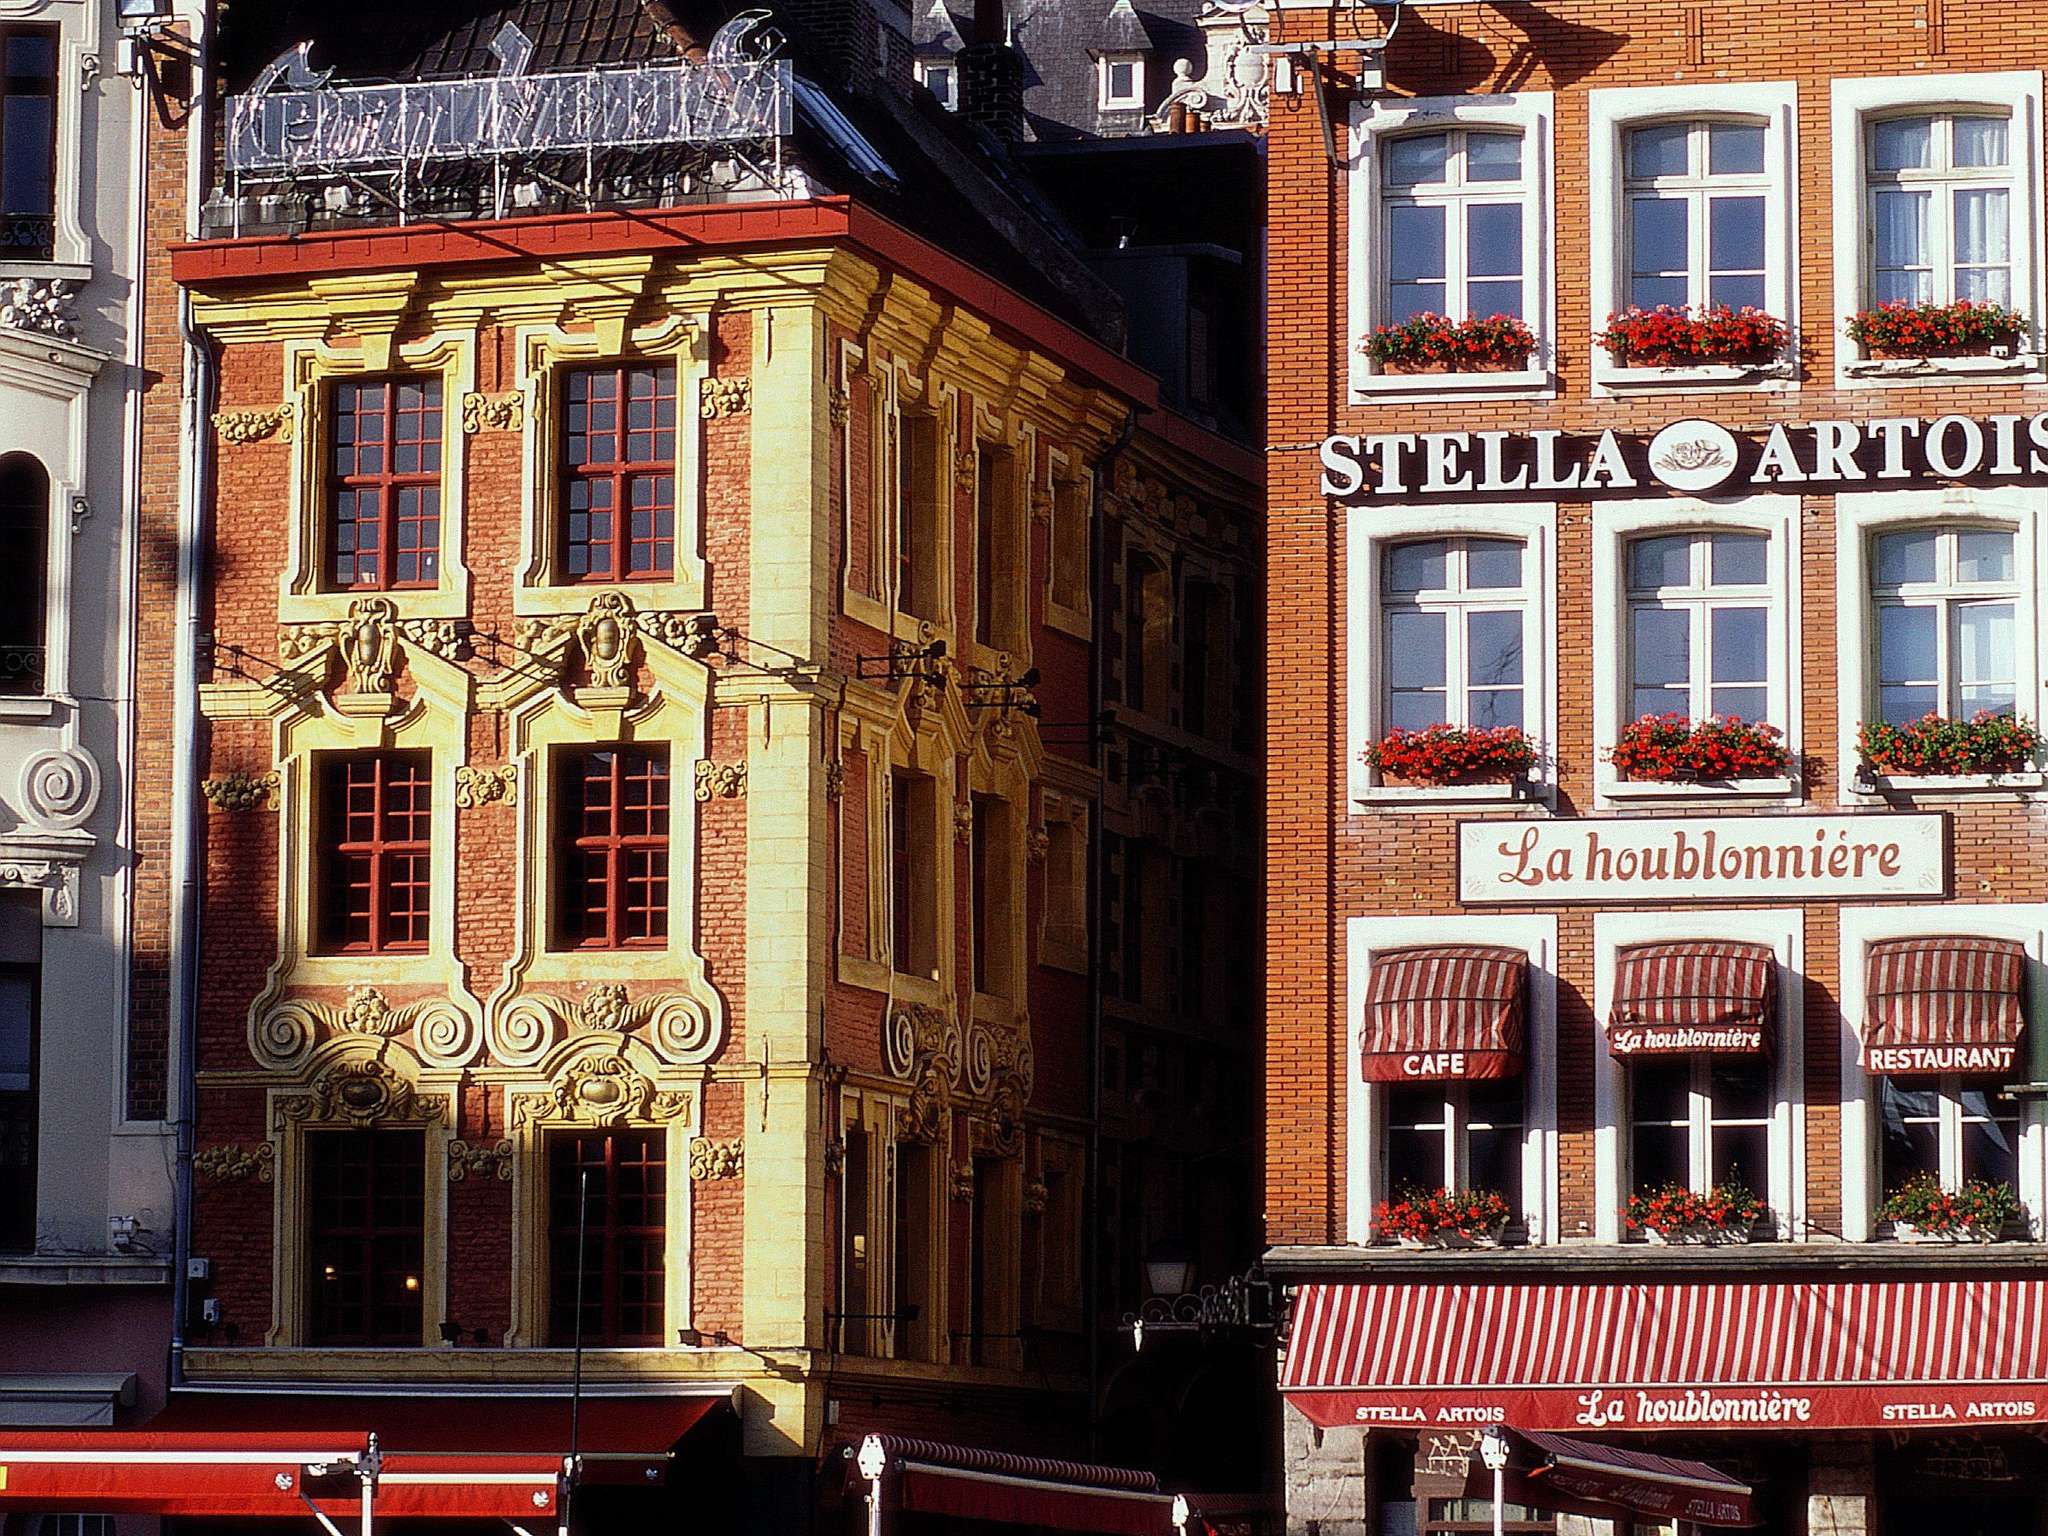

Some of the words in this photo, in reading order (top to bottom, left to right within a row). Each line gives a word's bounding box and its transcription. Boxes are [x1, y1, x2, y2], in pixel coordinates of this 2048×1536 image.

[1320, 428, 1637, 496] STELLA
[1498, 827, 1572, 886] La
[1614, 1029, 1642, 1053] La
[1644, 1027, 1761, 1049] houblonnière
[1403, 1053, 1464, 1076] CAFE
[1870, 1047, 2016, 1070] RESTAURANT
[1355, 1406, 1427, 1422] STELLA
[1436, 1406, 1506, 1422] ARTOIS
[1576, 1389, 1625, 1427] La
[1636, 1390, 1811, 1423] houblonnière
[1882, 1403, 1957, 1420] STELLA
[1965, 1401, 2036, 1418] ARTOIS
